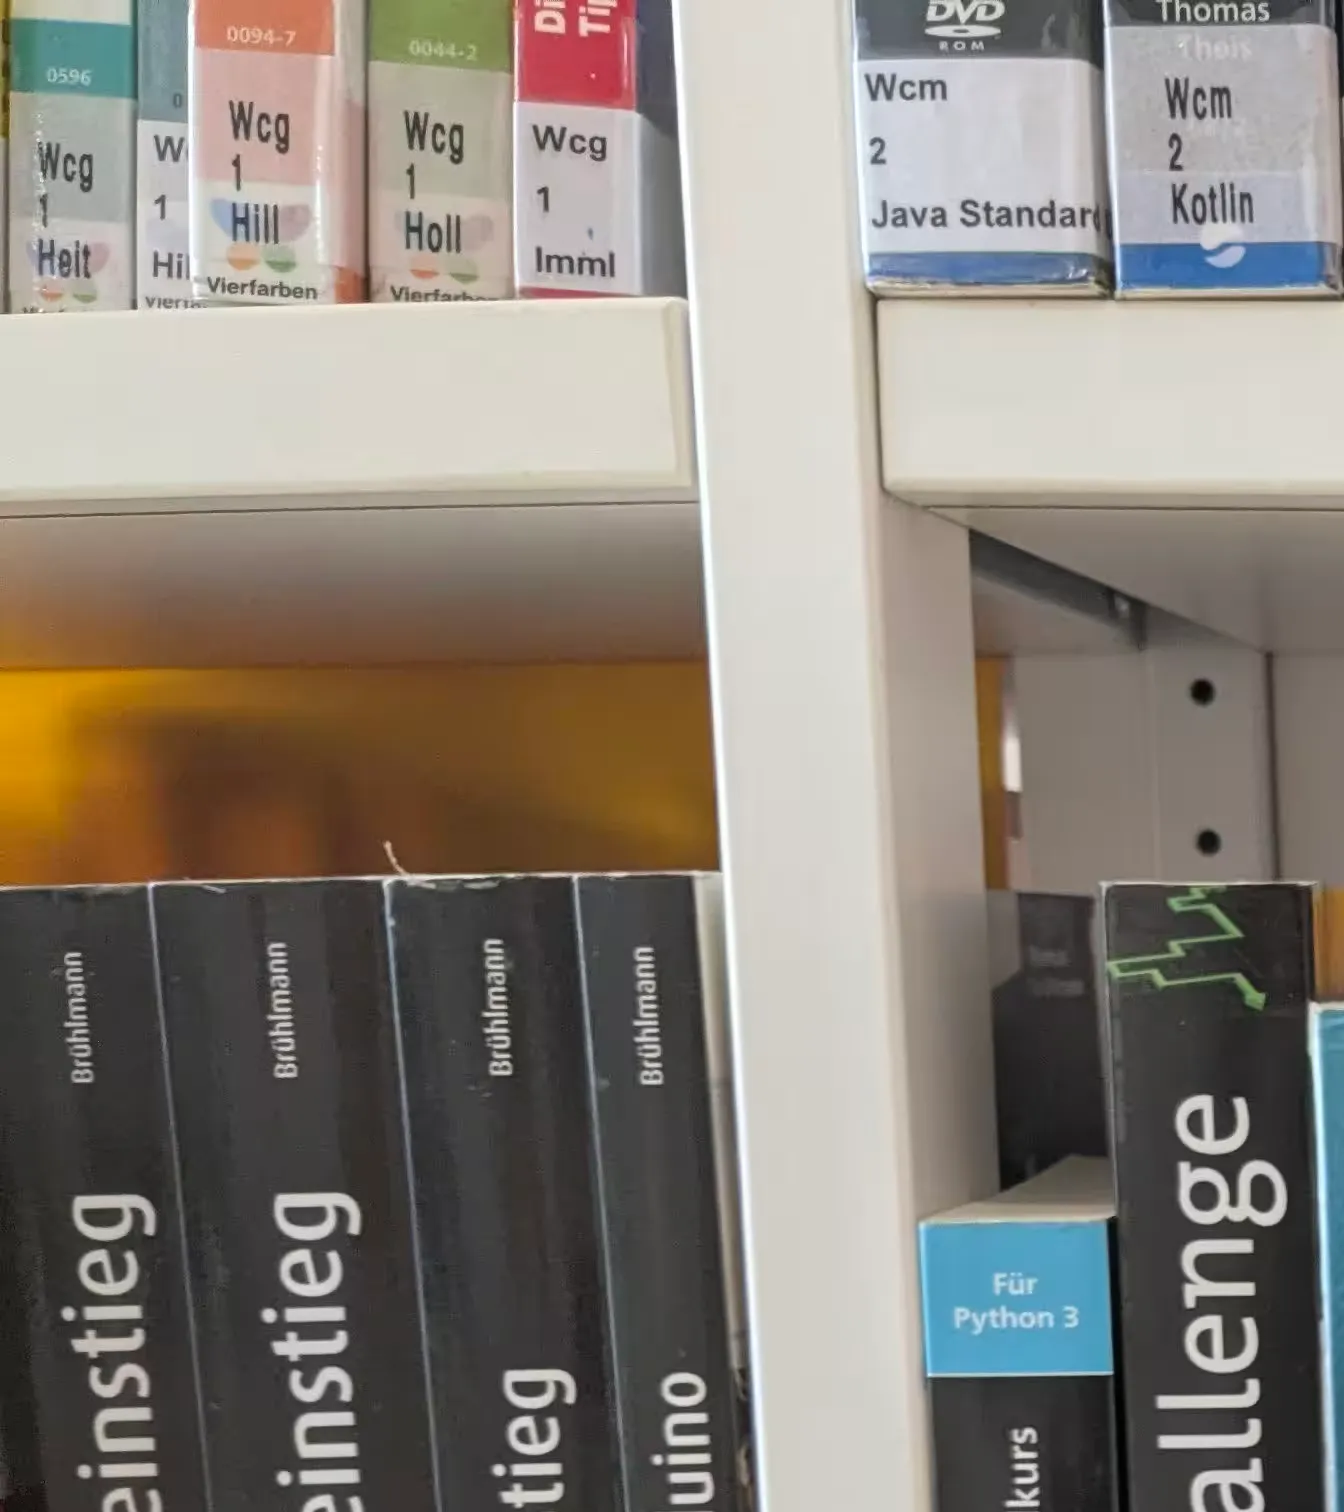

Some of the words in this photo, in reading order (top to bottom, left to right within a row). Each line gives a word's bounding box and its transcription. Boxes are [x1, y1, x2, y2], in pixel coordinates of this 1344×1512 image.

[226, 25, 297, 46] 0094-7
[408, 39, 478, 60] 0044-2
[46, 67, 92, 86] 0596
[229, 100, 290, 153] Wcg
[231, 203, 280, 244] Hill
[1171, 183, 1255, 225] Kotlin
[405, 212, 461, 253] Holl
[206, 276, 318, 300] Vierfarben
[65, 951, 95, 1084] Brühlmann
[266, 941, 298, 1079] Brühlmann
[482, 938, 513, 1077] Brühlmann
[632, 946, 664, 1086] Brühlmann
[993, 1271, 1038, 1296] Für
[953, 1306, 1053, 1333] Python
[1063, 1306, 1079, 1328] 3
